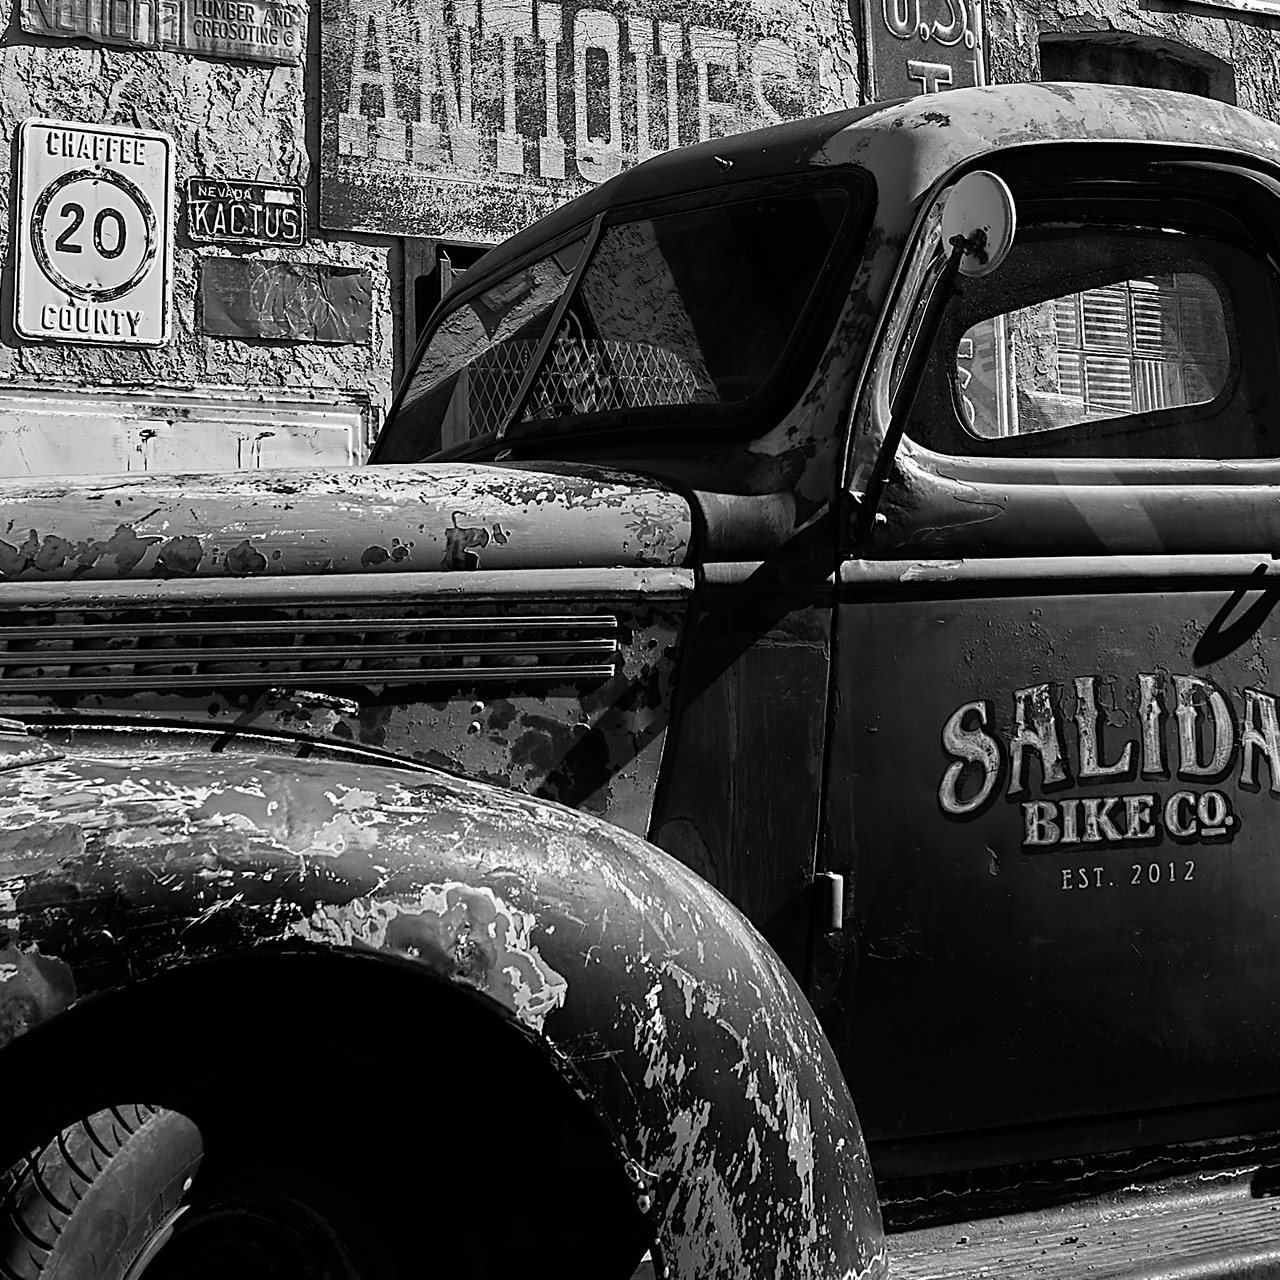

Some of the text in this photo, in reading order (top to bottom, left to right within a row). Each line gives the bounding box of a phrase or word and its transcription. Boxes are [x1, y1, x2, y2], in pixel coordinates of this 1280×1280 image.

[193, 19, 279, 46] CREOSOTING
[263, 8, 293, 28] AND
[46, 130, 148, 167] CHAFFEE
[198, 185, 252, 200] NEVADA
[55, 202, 127, 260] 20
[195, 202, 298, 239] KACTUS
[40, 303, 144, 337] COUNTY
[1021, 793, 1157, 847] BIKE
[1061, 860, 1196, 891] EST. 2012
